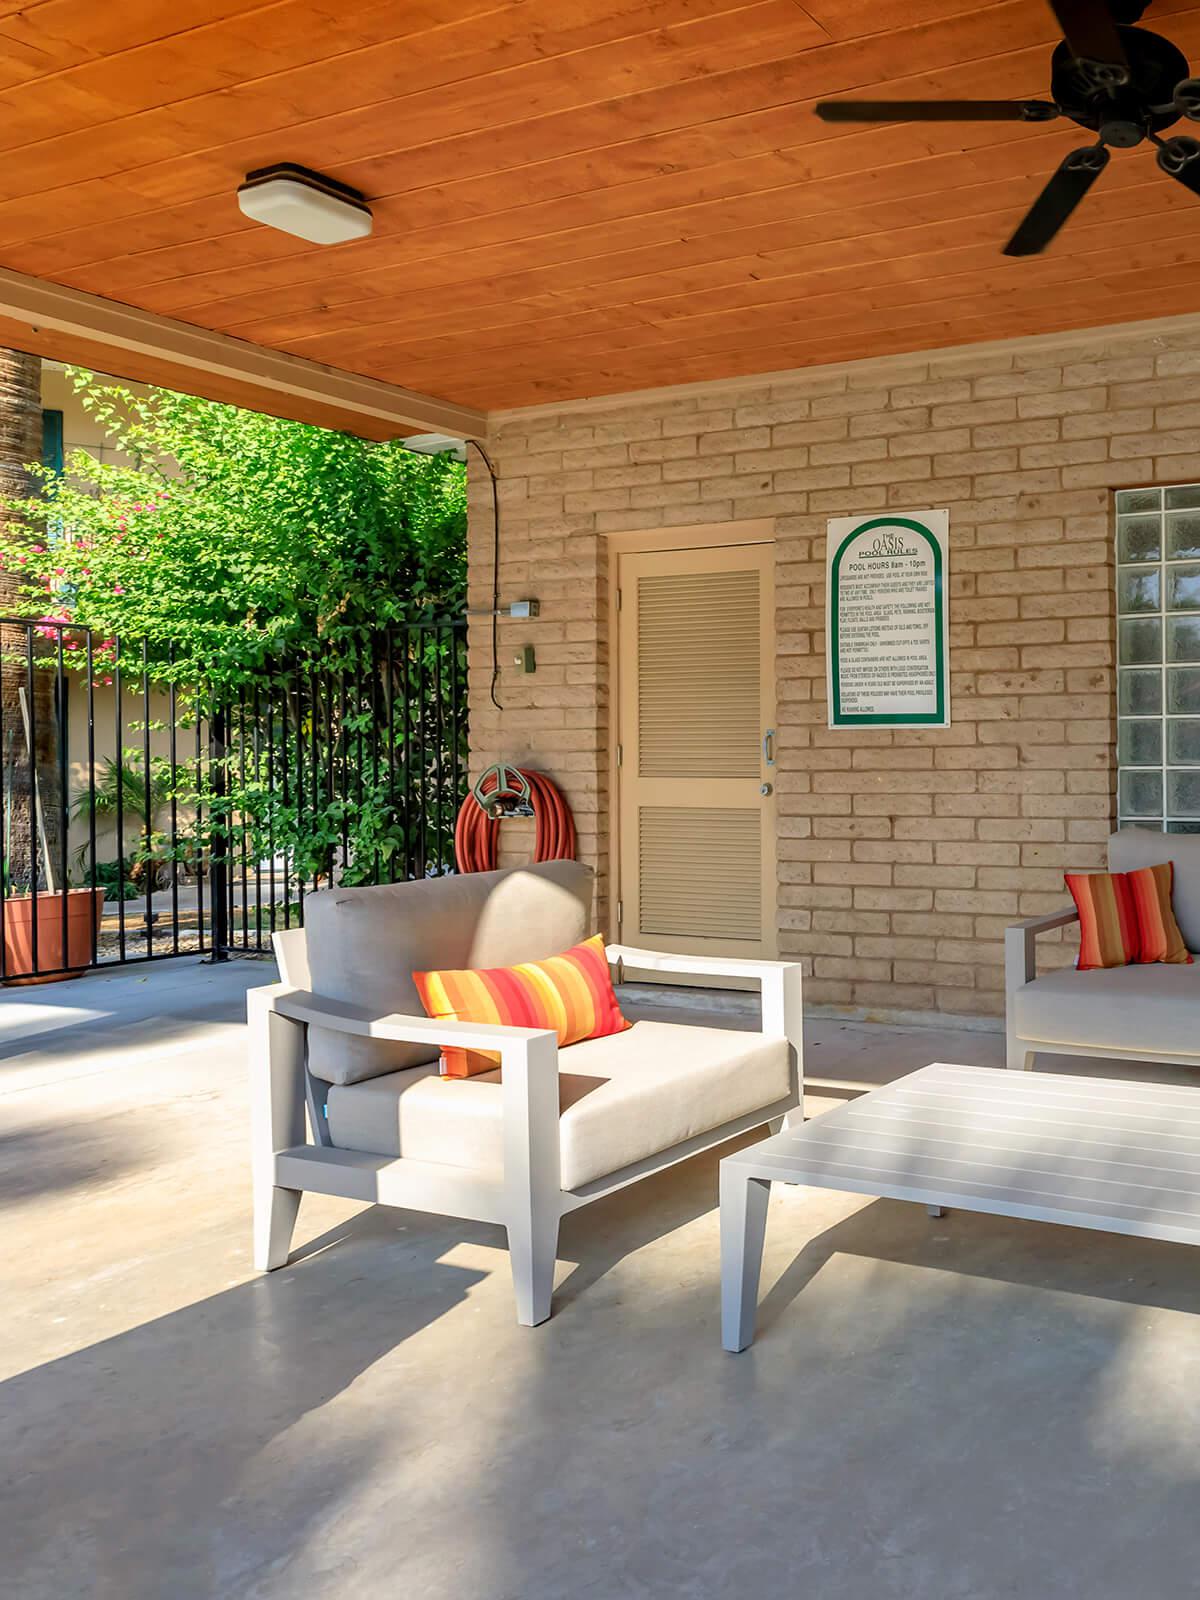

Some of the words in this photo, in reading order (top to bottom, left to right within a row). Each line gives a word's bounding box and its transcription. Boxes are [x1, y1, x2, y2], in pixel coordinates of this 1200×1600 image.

[872, 536, 904, 552] OASIS
[849, 564, 866, 572] POOL
[868, 562, 890, 570] HOURS
[910, 560, 926, 568] 10pm
